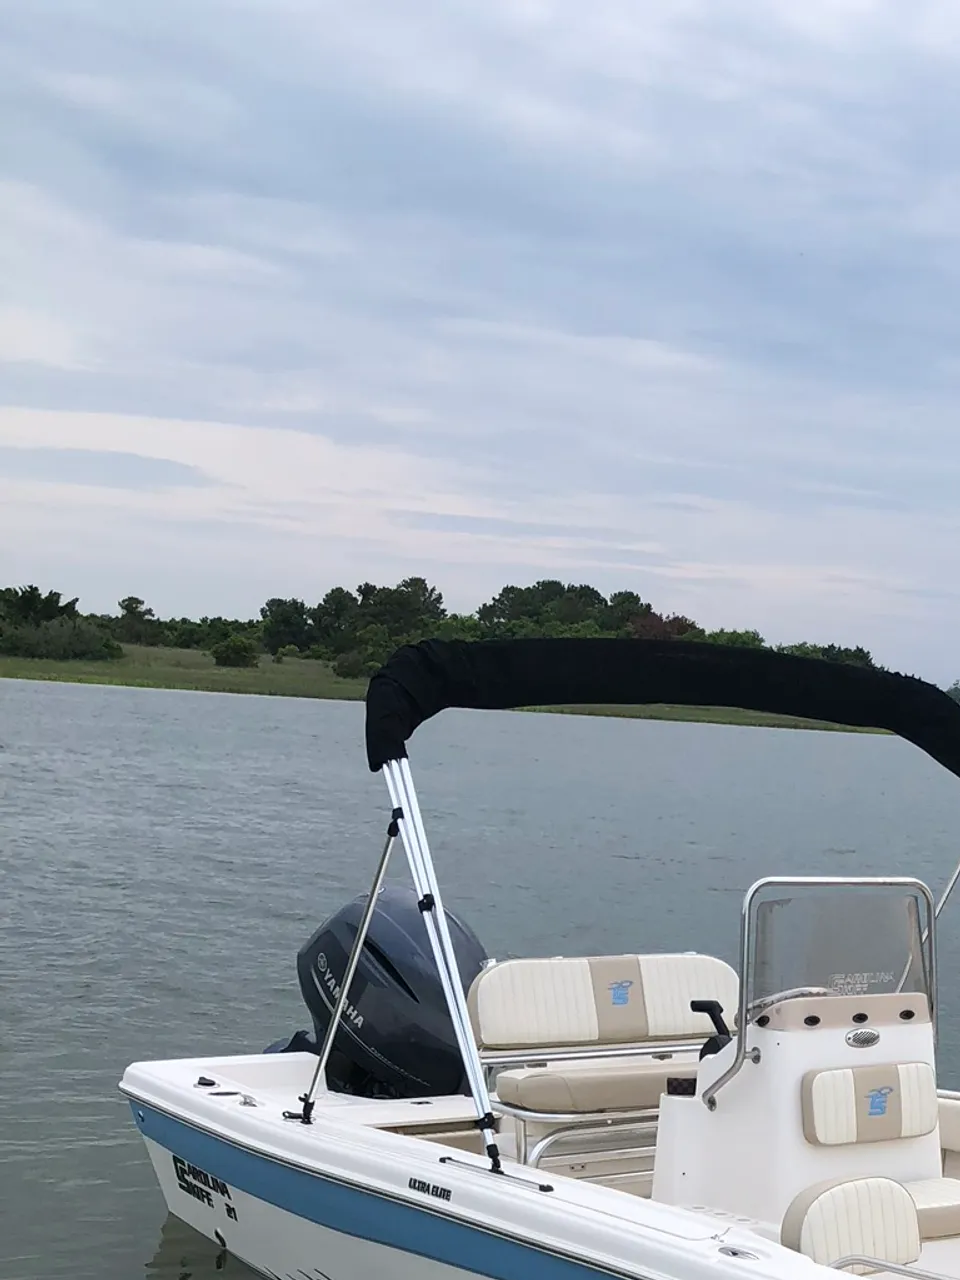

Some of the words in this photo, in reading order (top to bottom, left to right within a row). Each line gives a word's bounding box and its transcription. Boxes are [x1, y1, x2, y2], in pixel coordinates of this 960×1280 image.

[408, 1177, 431, 1195] ULTRA
[431, 1184, 452, 1202] ELITE
[224, 1202, 239, 1222] 21
